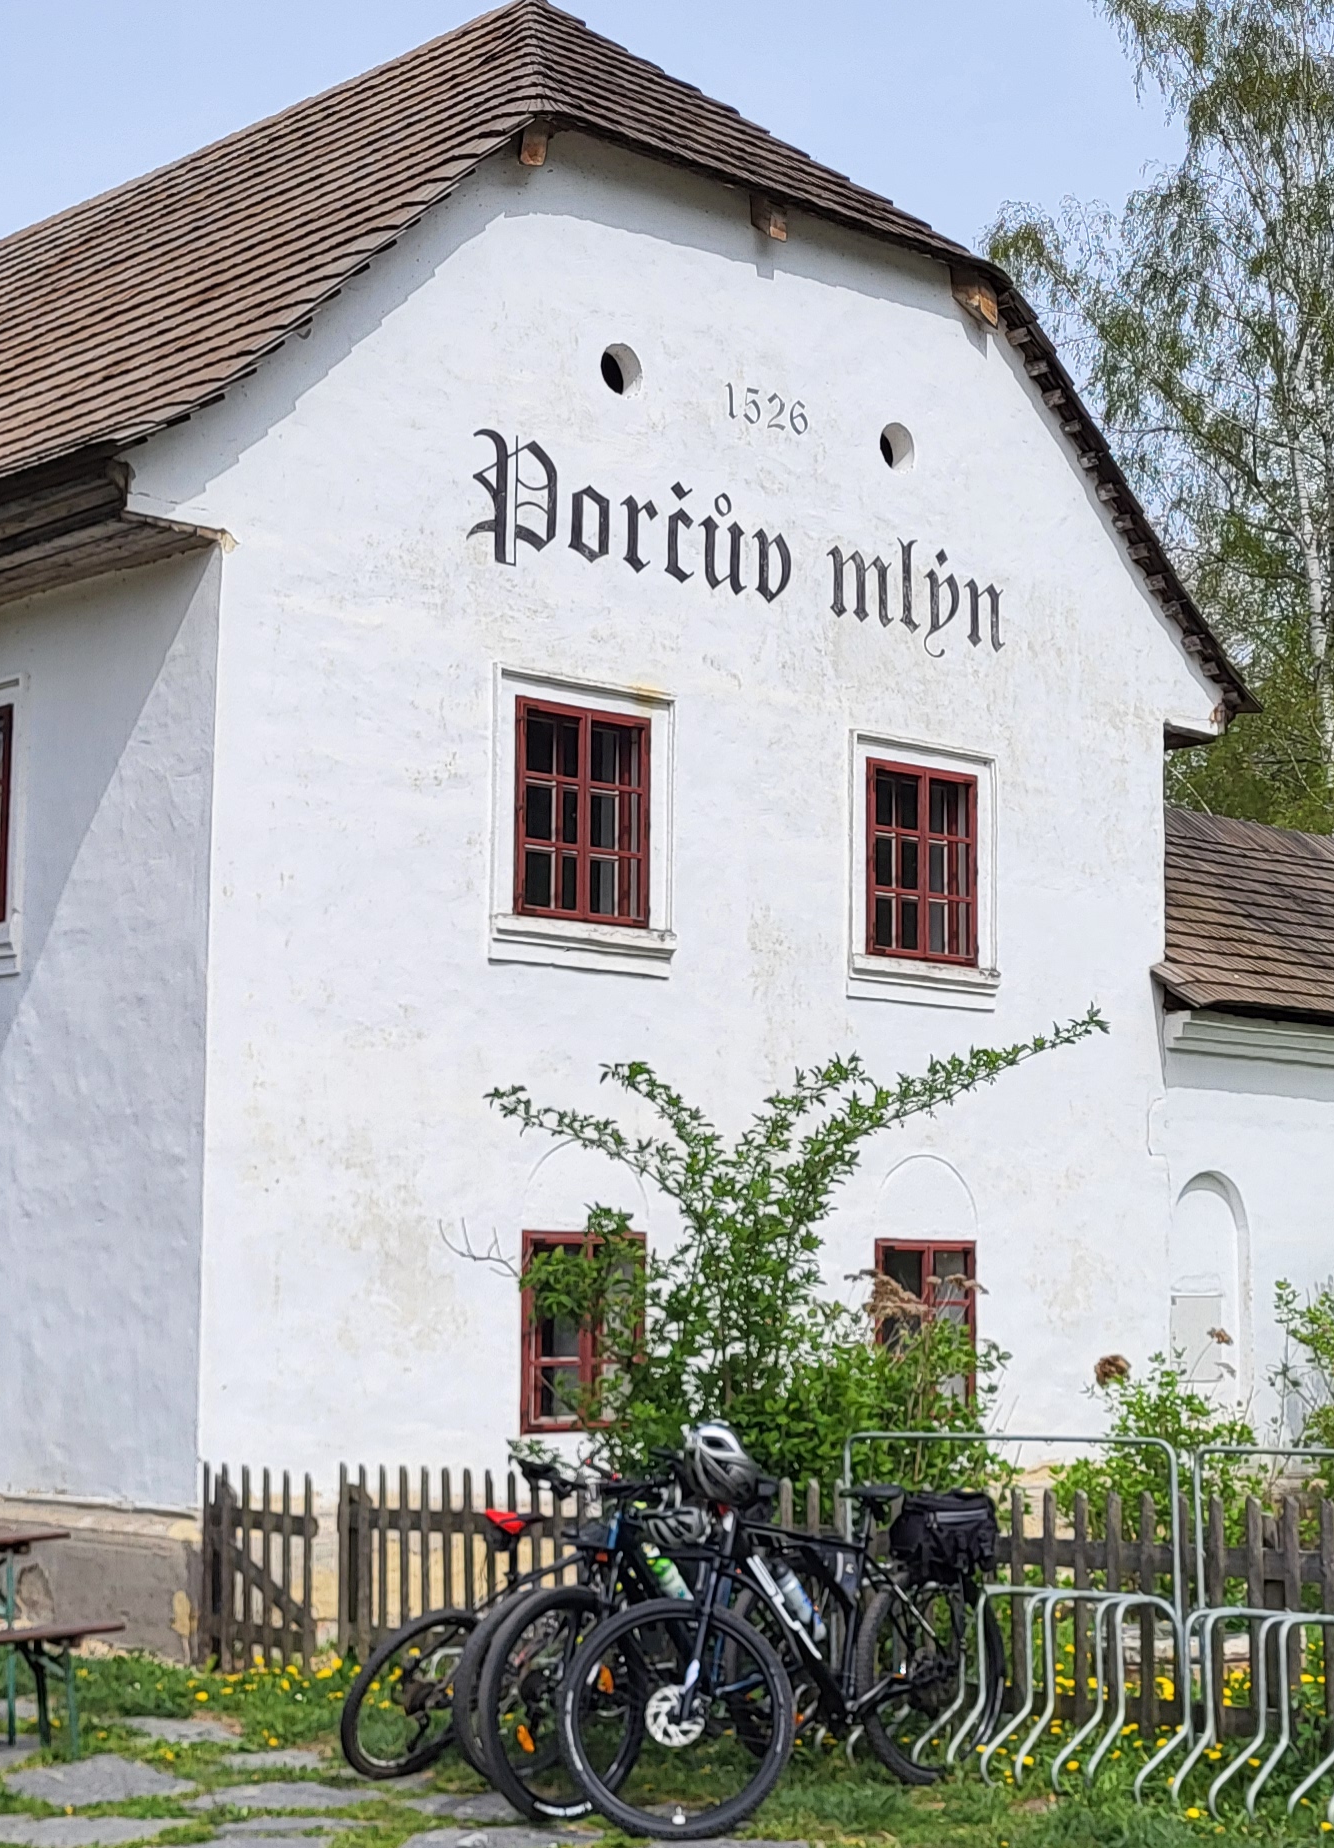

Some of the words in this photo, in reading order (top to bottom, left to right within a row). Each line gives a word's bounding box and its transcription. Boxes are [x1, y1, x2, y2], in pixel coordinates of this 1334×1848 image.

[726, 382, 809, 435] 1526
[467, 428, 792, 602] Porčův
[827, 537, 1005, 657] mlýn
